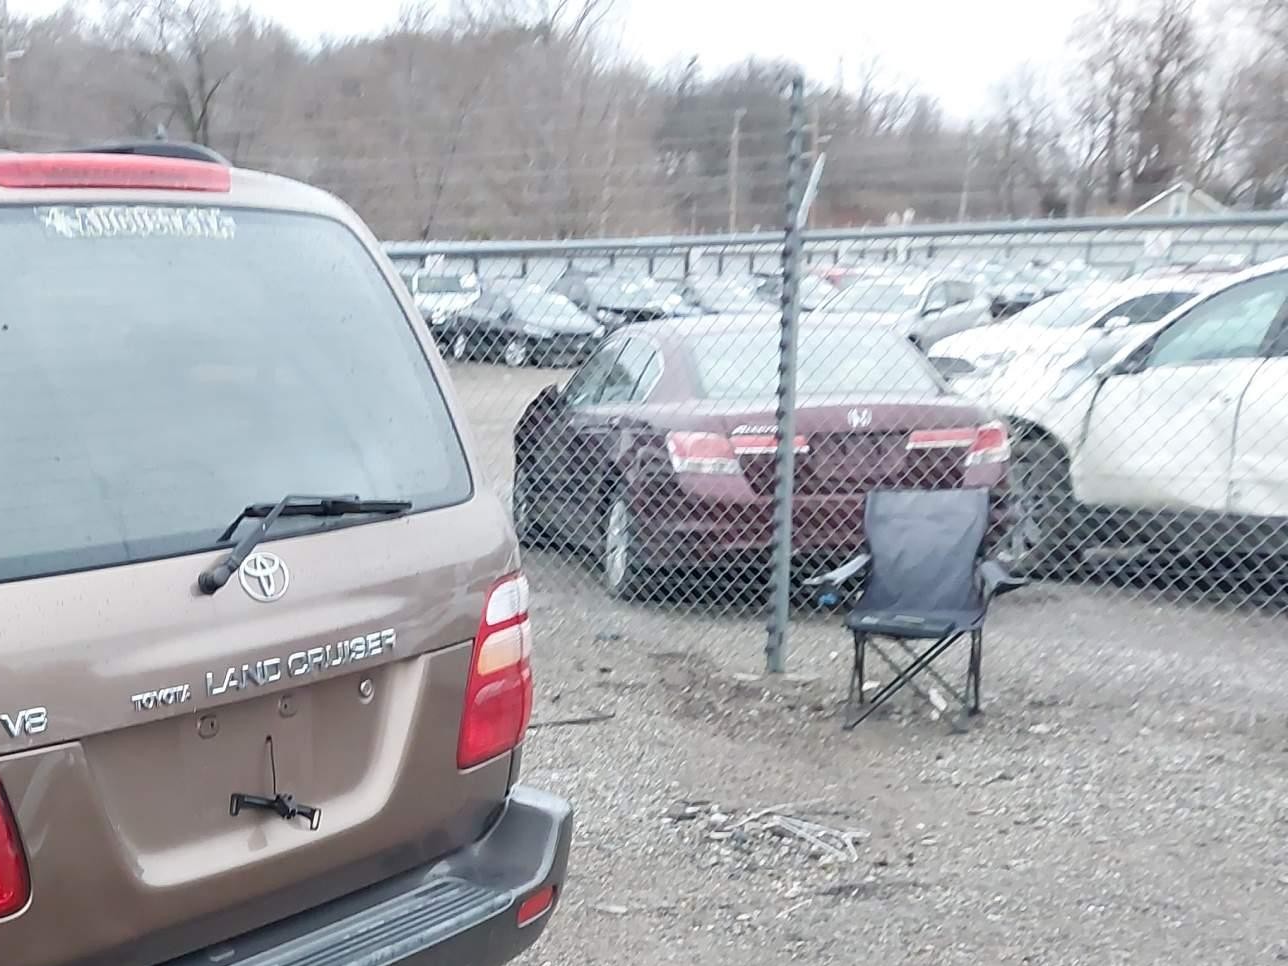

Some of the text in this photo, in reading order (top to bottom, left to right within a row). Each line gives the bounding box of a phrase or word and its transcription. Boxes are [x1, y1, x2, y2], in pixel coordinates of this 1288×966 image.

[131, 628, 398, 711] TOYOTA LAND CRUISER
[0, 707, 48, 737] V8
